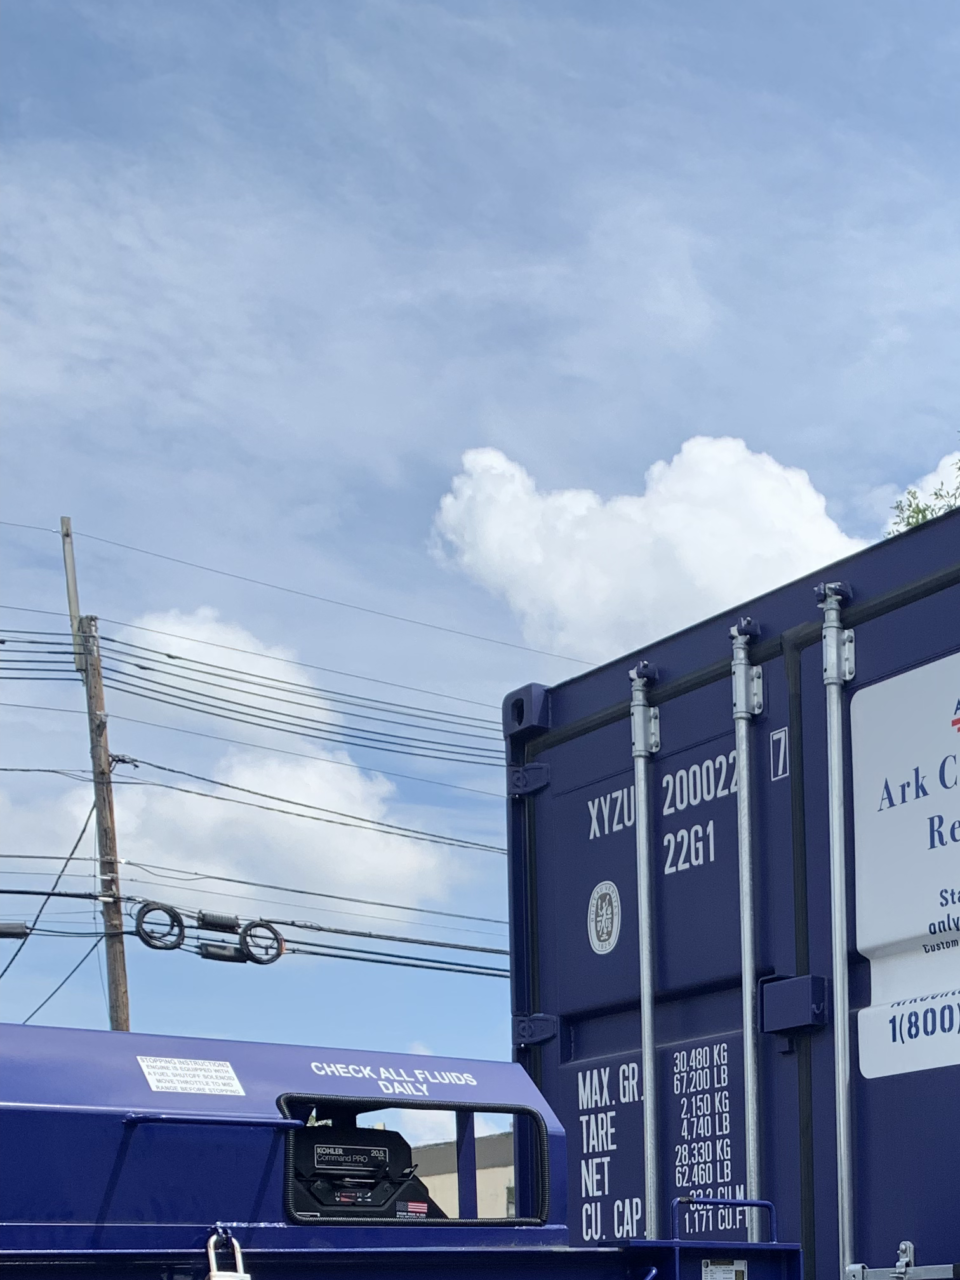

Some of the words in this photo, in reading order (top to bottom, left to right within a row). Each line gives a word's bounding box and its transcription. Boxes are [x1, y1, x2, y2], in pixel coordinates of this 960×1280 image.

[587, 786, 635, 840] XYZU
[662, 750, 738, 816] 200022
[772, 730, 786, 776] 7
[877, 766, 930, 812] Ark
[663, 820, 715, 875] 22G1
[928, 913, 960, 936] only
[922, 938, 959, 954] Custom
[140, 1057, 176, 1066] STOPPING
[178, 1059, 230, 1068] INSTRUCTIONS
[180, 1066, 213, 1074] EQUIPPED
[673, 1046, 710, 1073] 30,480
[713, 1043, 728, 1066] KG
[310, 1062, 378, 1080] CHECK
[379, 1067, 415, 1082] ALL
[414, 1069, 478, 1086] FLUIDS
[378, 1080, 430, 1096] DAILY
[578, 1066, 616, 1110] MAX.
[673, 1070, 710, 1095] 67,200
[714, 1065, 728, 1088] LB
[680, 1094, 711, 1120] 2,150
[714, 1090, 730, 1114] KG
[579, 1111, 618, 1154] TARE
[681, 1116, 712, 1141] 4,740
[715, 1113, 730, 1136] LB
[316, 1154, 352, 1162] Command
[674, 1140, 712, 1166] 28,330
[716, 1138, 731, 1161] KG
[580, 1156, 611, 1198] NET
[675, 1163, 713, 1188] 62,460
[716, 1160, 732, 1184] LB
[582, 1202, 606, 1242] CU.
[684, 1210, 713, 1234] 1,171
